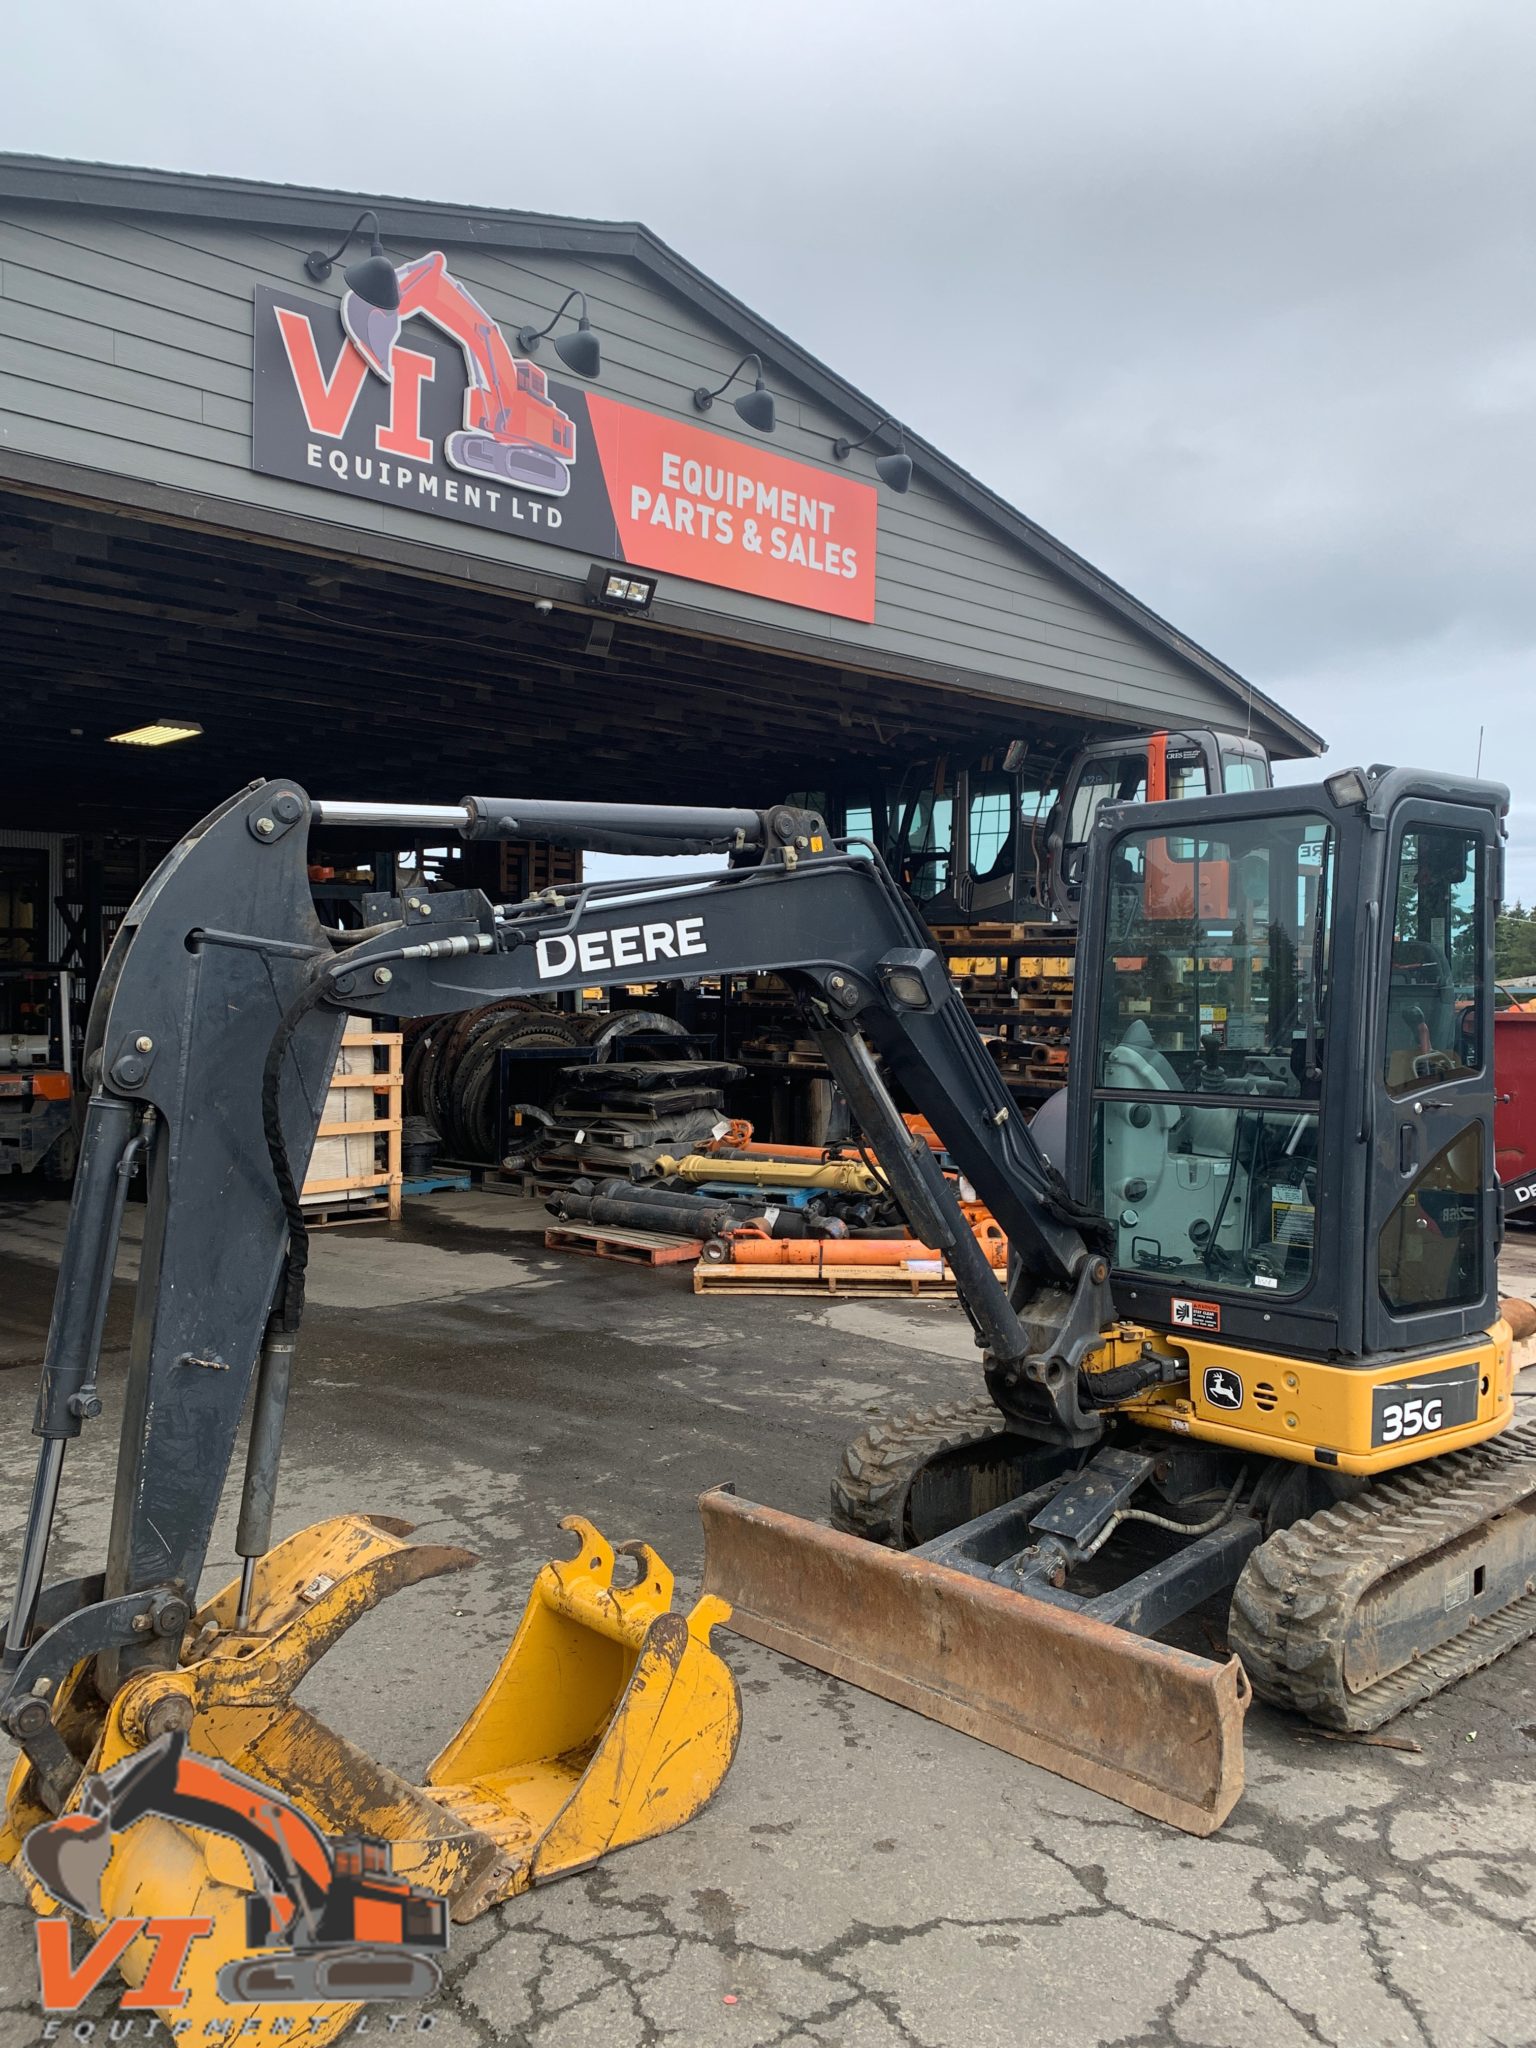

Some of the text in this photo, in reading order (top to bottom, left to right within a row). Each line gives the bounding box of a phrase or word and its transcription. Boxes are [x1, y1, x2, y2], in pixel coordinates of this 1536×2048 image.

[273, 306, 436, 464] VI
[307, 443, 563, 528] EQUIPMENT LTD
[662, 451, 836, 535] EQUIPMENT
[631, 485, 857, 579] PARTS & SALES
[536, 917, 707, 979] DEERE
[1382, 1399, 1442, 1441] 35G
